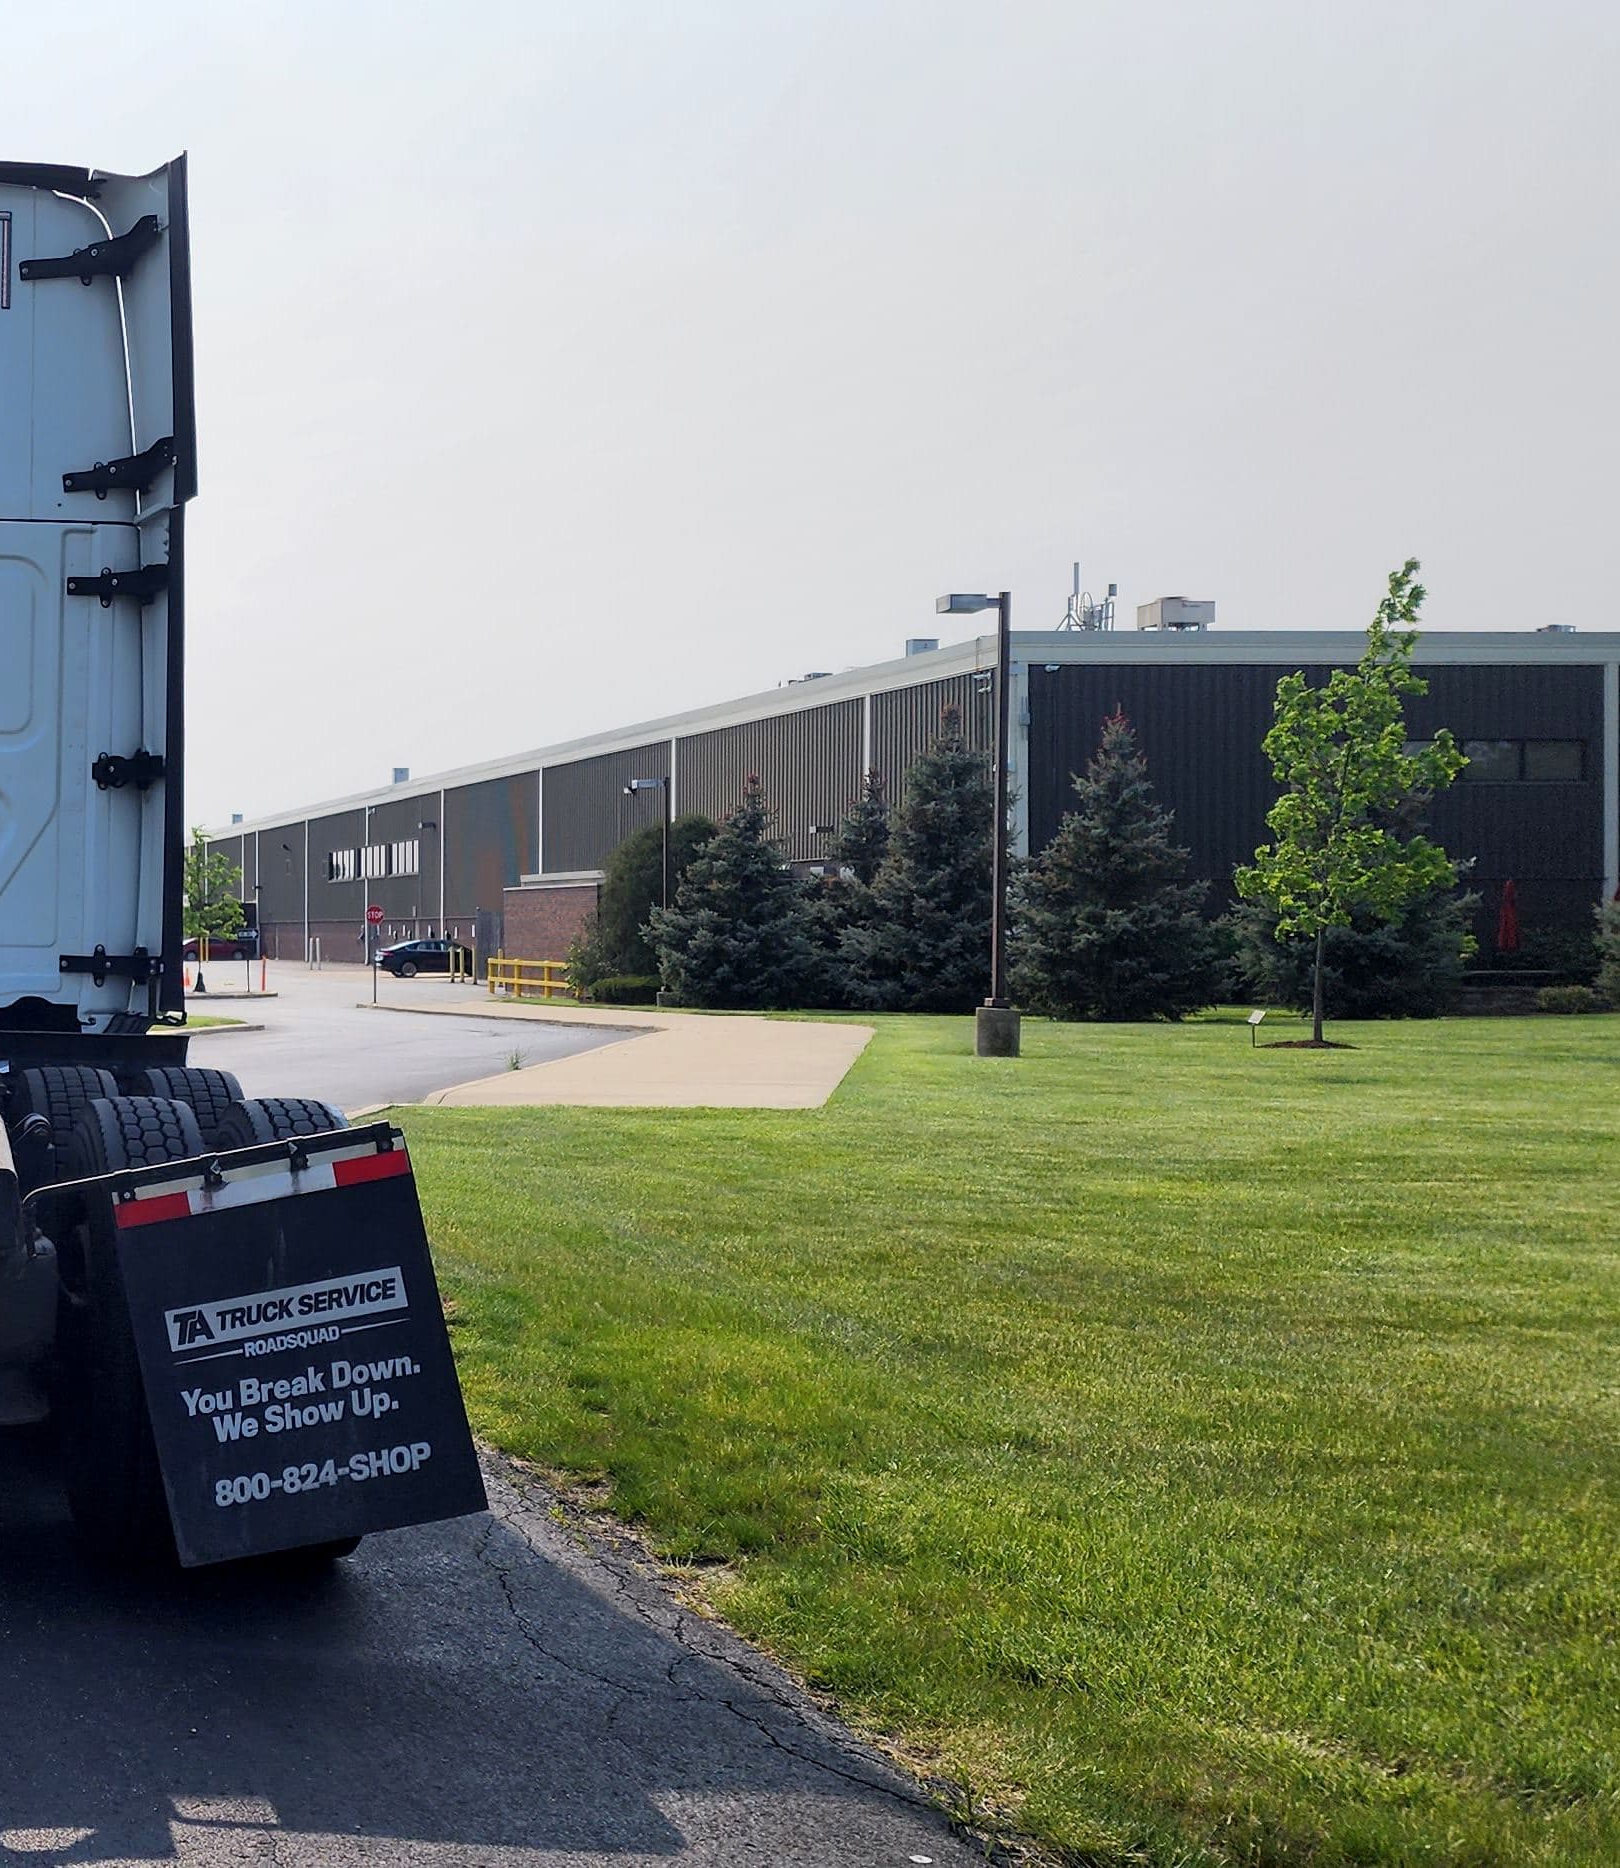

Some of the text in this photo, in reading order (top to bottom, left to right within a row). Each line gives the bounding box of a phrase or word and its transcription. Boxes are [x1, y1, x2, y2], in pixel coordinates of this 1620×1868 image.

[367, 911, 383, 919] STOP
[173, 1278, 397, 1346] TA TRUCK SERVICE
[244, 1325, 340, 1358] ROADSQUAD
[181, 1355, 421, 1417] You Break Down.
[213, 1387, 400, 1443] We Show Up.
[215, 1441, 432, 1507] 800-824-SHOP
